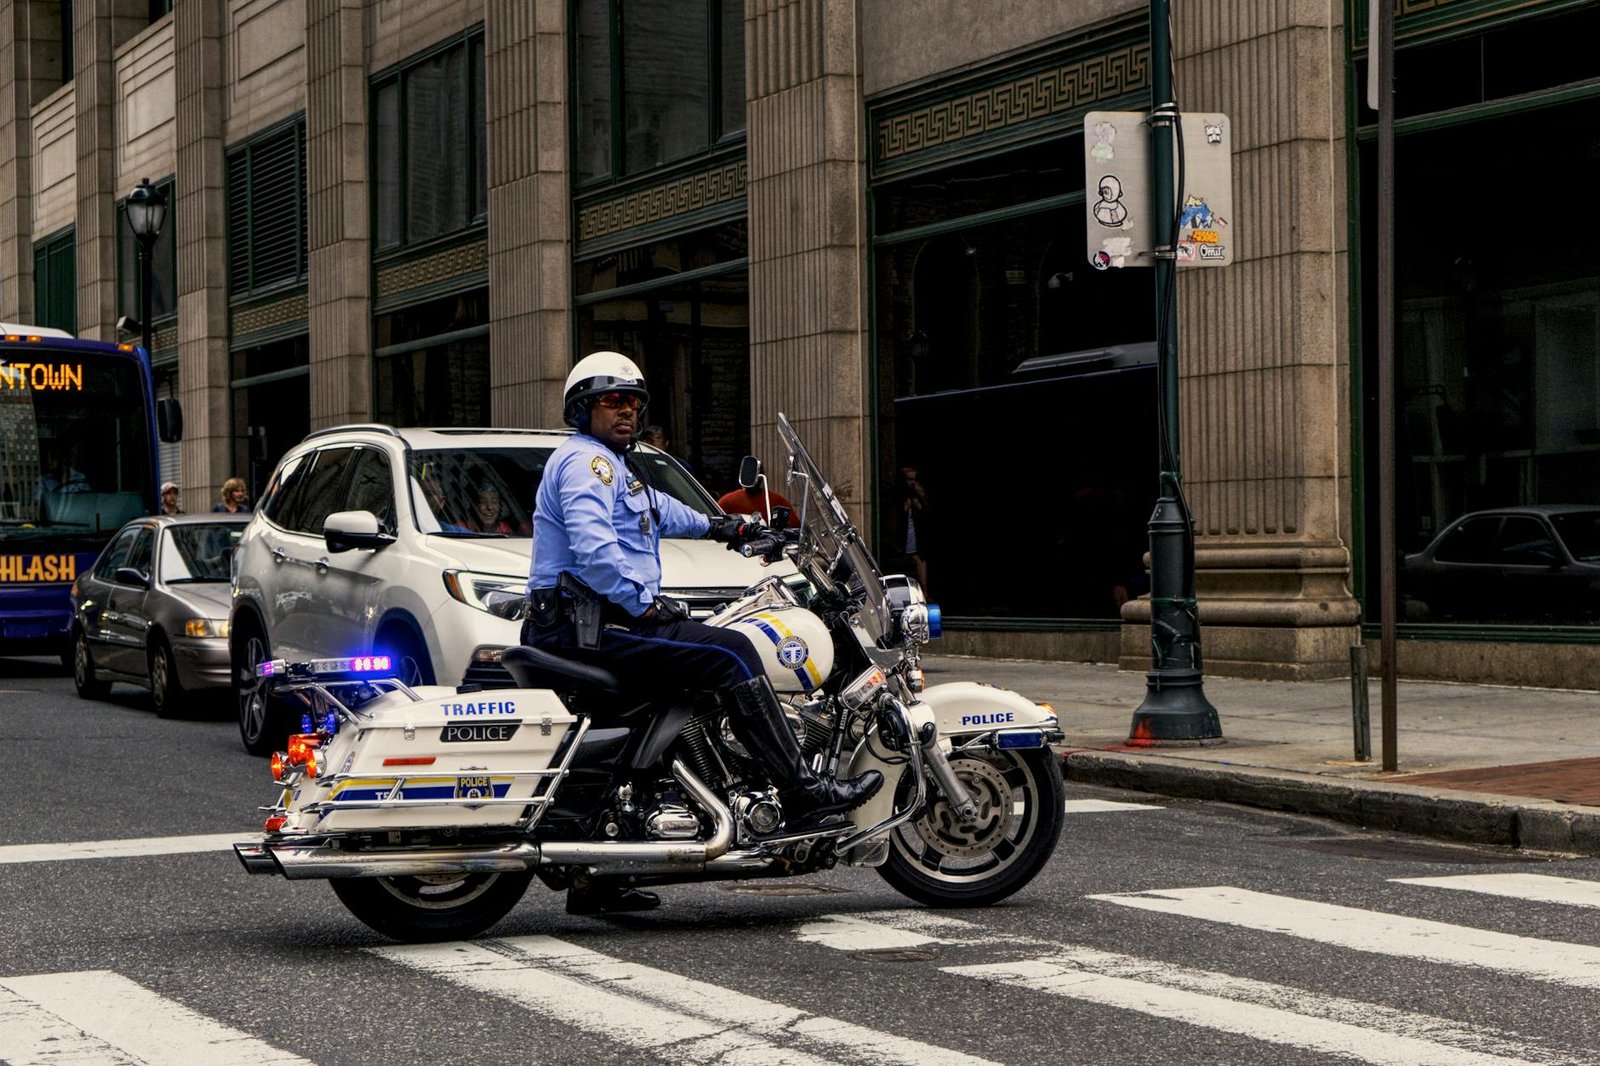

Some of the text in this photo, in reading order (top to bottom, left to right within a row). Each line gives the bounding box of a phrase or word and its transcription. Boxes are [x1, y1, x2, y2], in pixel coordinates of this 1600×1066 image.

[440, 702, 516, 716] TRAFFIC
[962, 712, 1014, 725] POLICE
[448, 726, 508, 740] POLICE
[461, 777, 487, 787] POLICE
